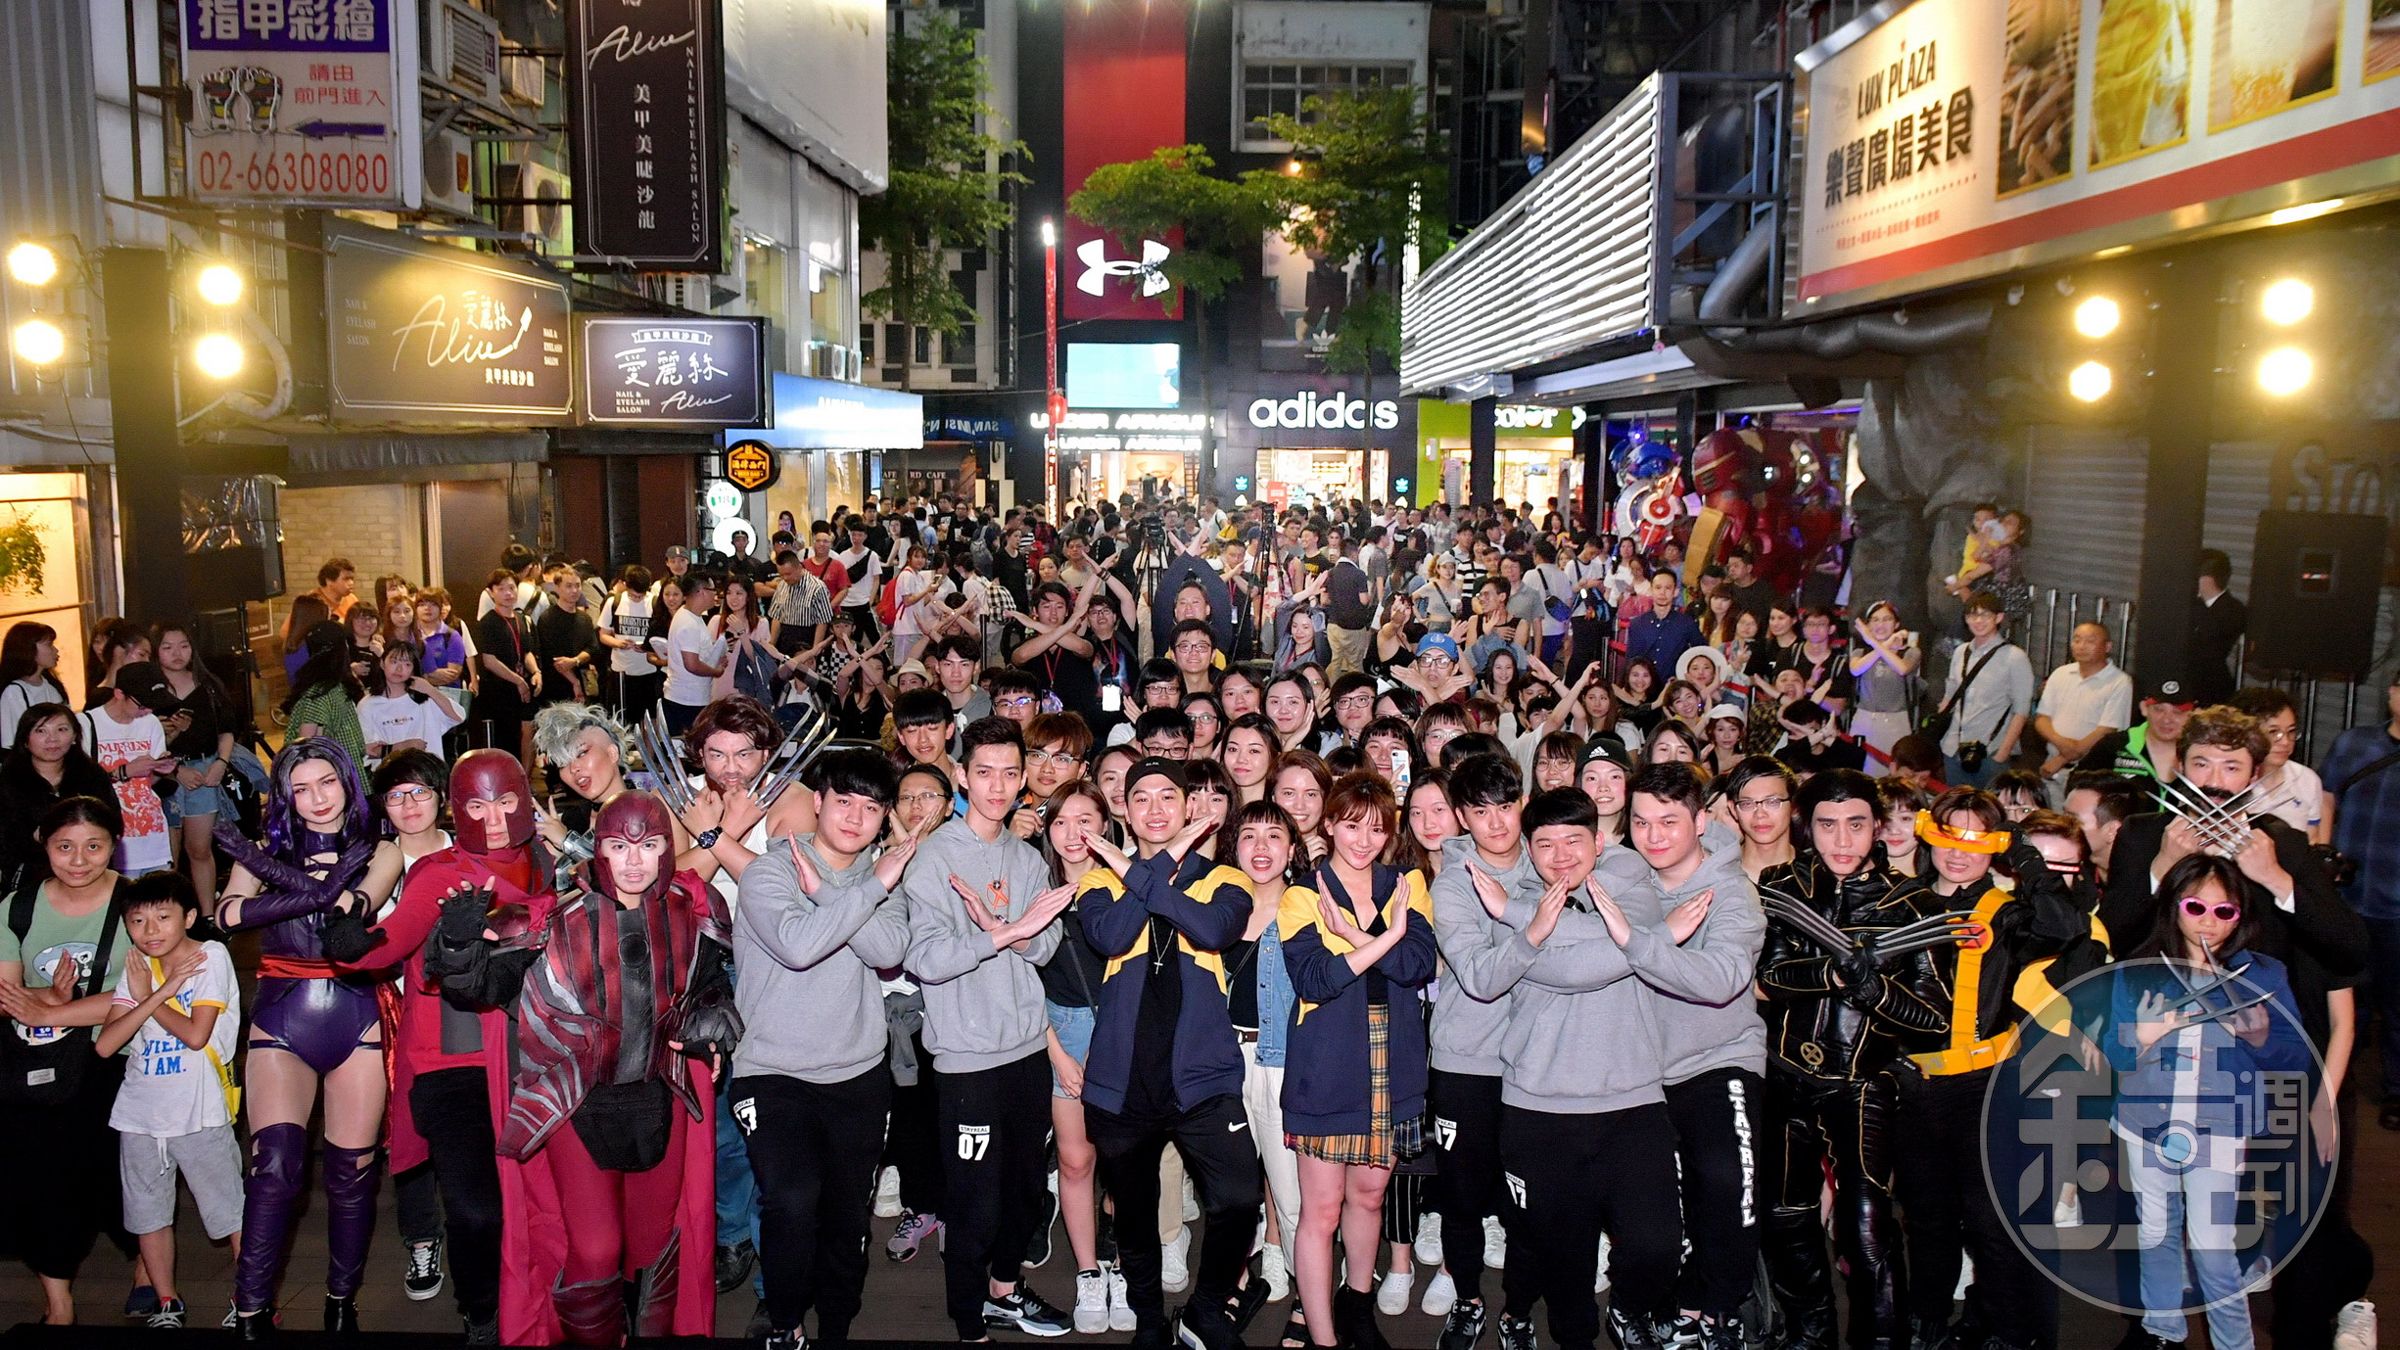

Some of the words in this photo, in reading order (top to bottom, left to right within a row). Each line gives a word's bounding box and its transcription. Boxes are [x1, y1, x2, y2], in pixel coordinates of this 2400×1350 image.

[197, 0, 374, 41] 指甲彩繪
[309, 64, 353, 82] 請由
[1857, 70, 1885, 120] LUX
[1888, 40, 1936, 103] PLAZA
[294, 88, 386, 106] 前門進入
[688, 107, 699, 184] EYELASH
[1825, 86, 1974, 209] 樂聲廣場美食
[200, 151, 387, 194] 02-66308080
[691, 189, 700, 243] SALON
[616, 406, 642, 414] SALON
[1249, 391, 1399, 430] adidas
[144, 1058, 150, 1075] I
[155, 1056, 187, 1075] AM.
[958, 1133, 990, 1161] 07
[1727, 1079, 1756, 1228] STAYREAL
